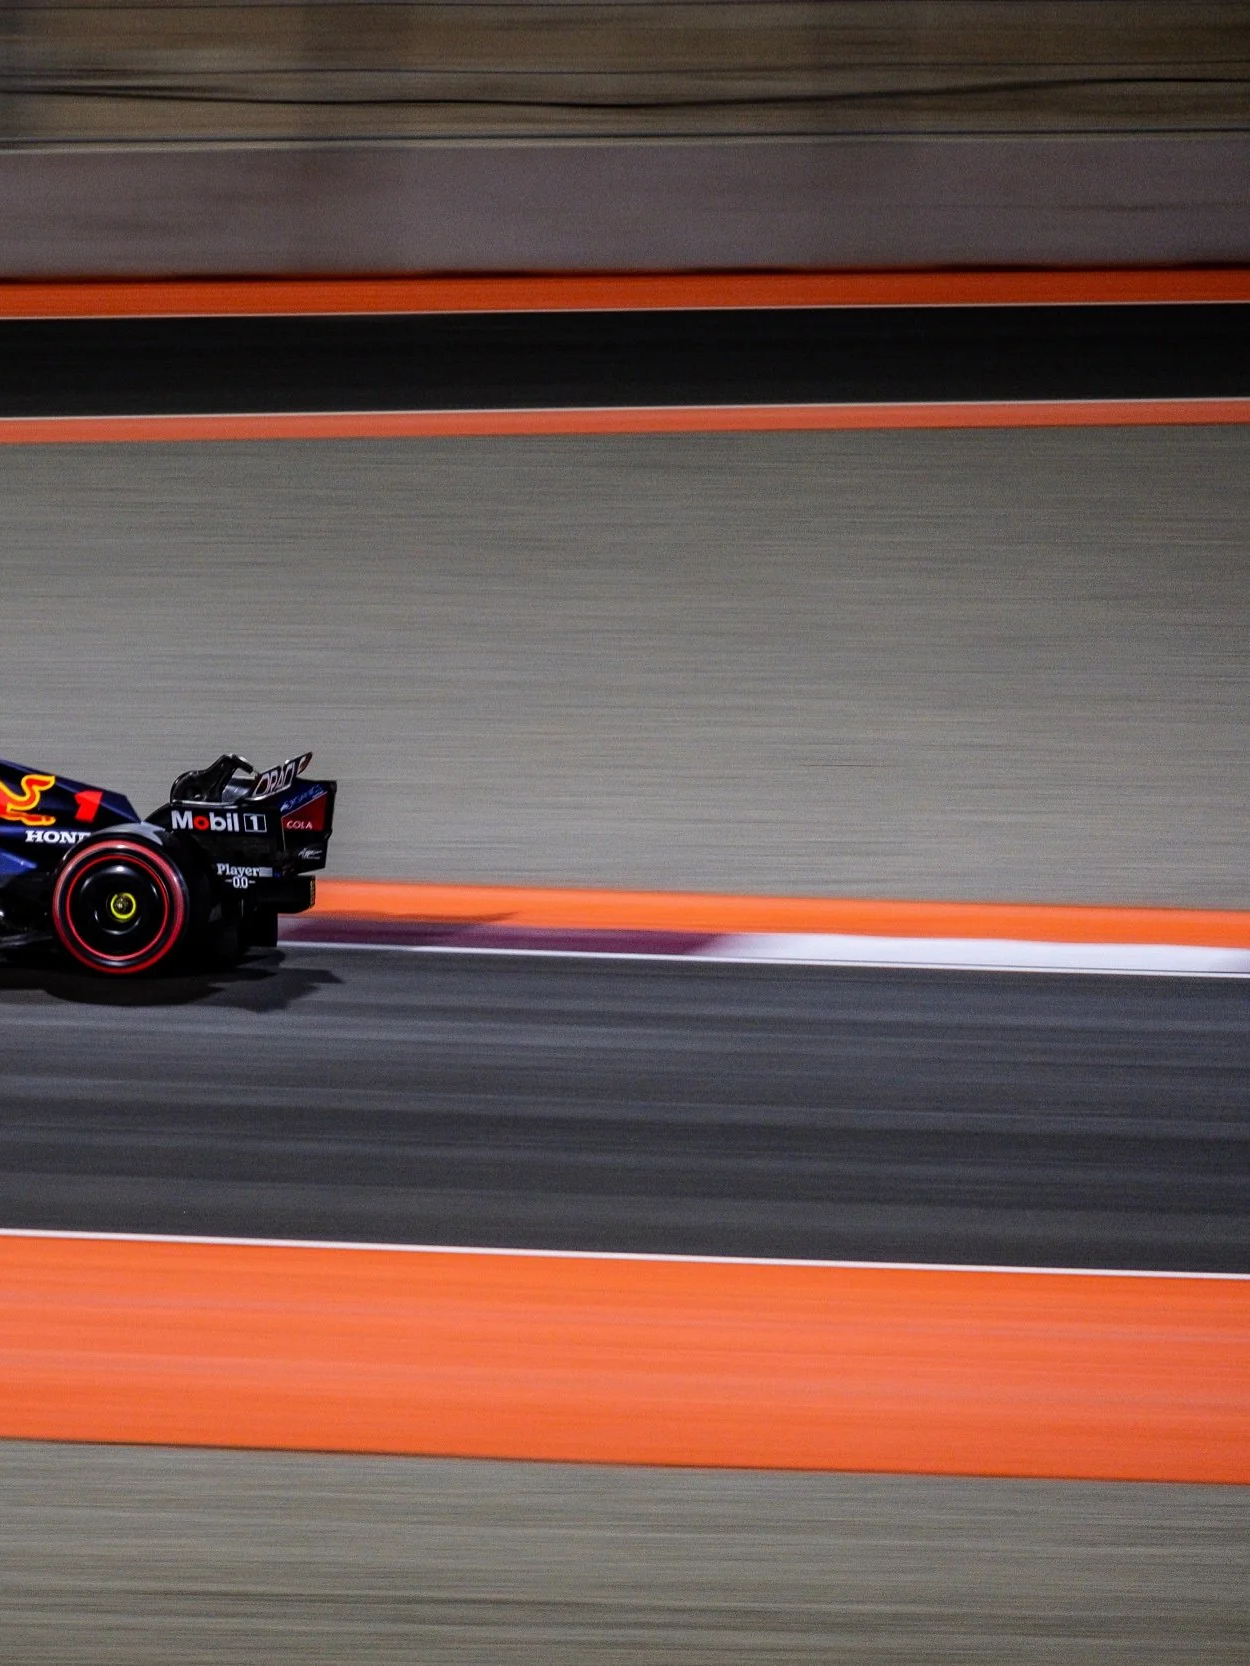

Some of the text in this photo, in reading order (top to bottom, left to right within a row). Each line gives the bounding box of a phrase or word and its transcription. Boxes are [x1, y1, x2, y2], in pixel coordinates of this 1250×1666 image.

[74, 790, 103, 823] 1
[171, 810, 239, 832] Mobil
[286, 820, 313, 829] COLA
[25, 830, 91, 844] HON
